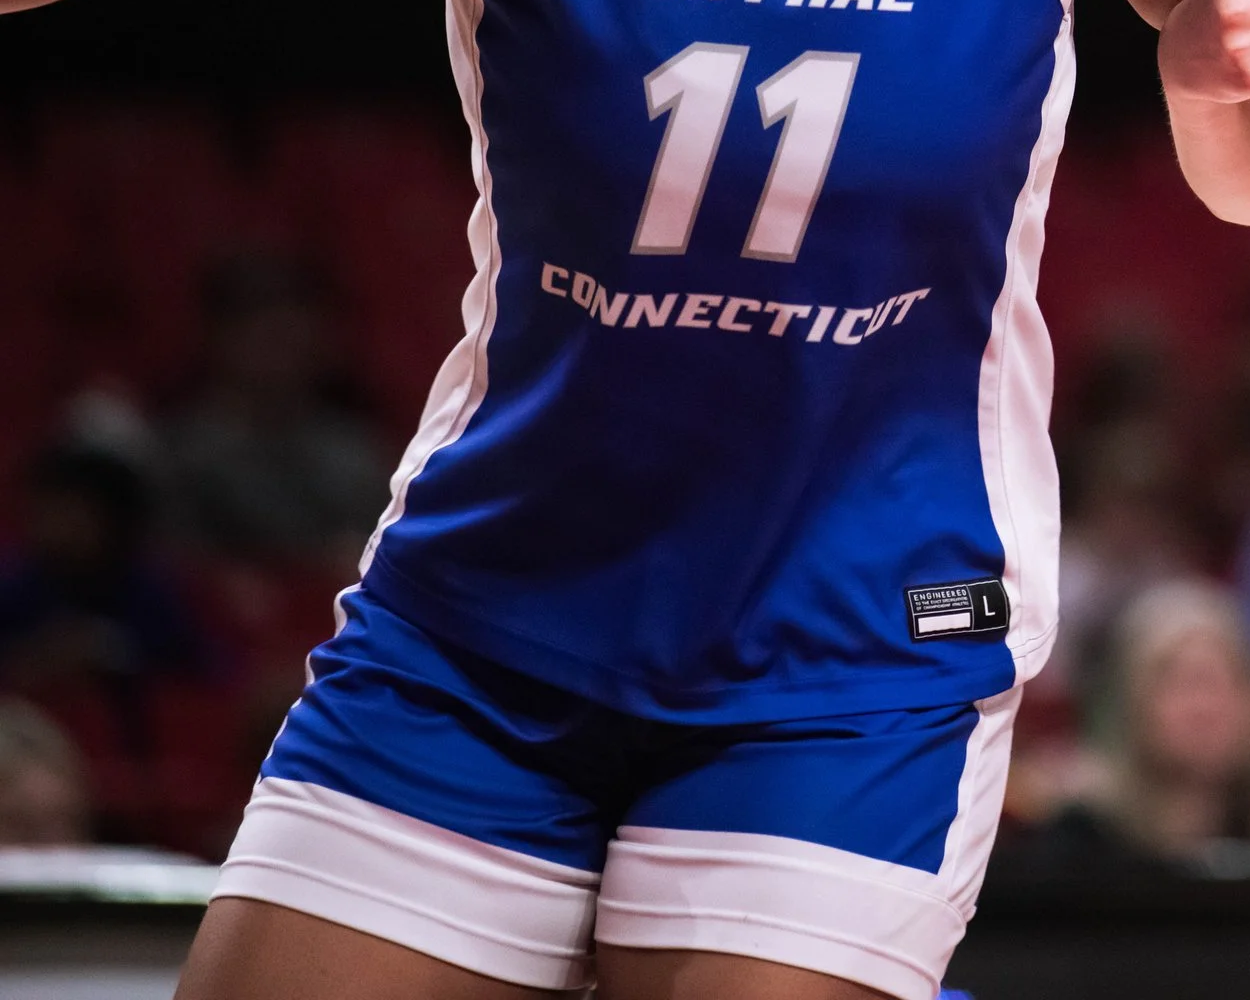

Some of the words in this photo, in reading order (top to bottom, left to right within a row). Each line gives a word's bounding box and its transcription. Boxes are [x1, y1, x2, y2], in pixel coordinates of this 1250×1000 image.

[629, 41, 861, 264] 11
[541, 261, 932, 346] CONNECTICUT
[913, 589, 967, 601] ENGINEERED
[983, 595, 996, 616] L
